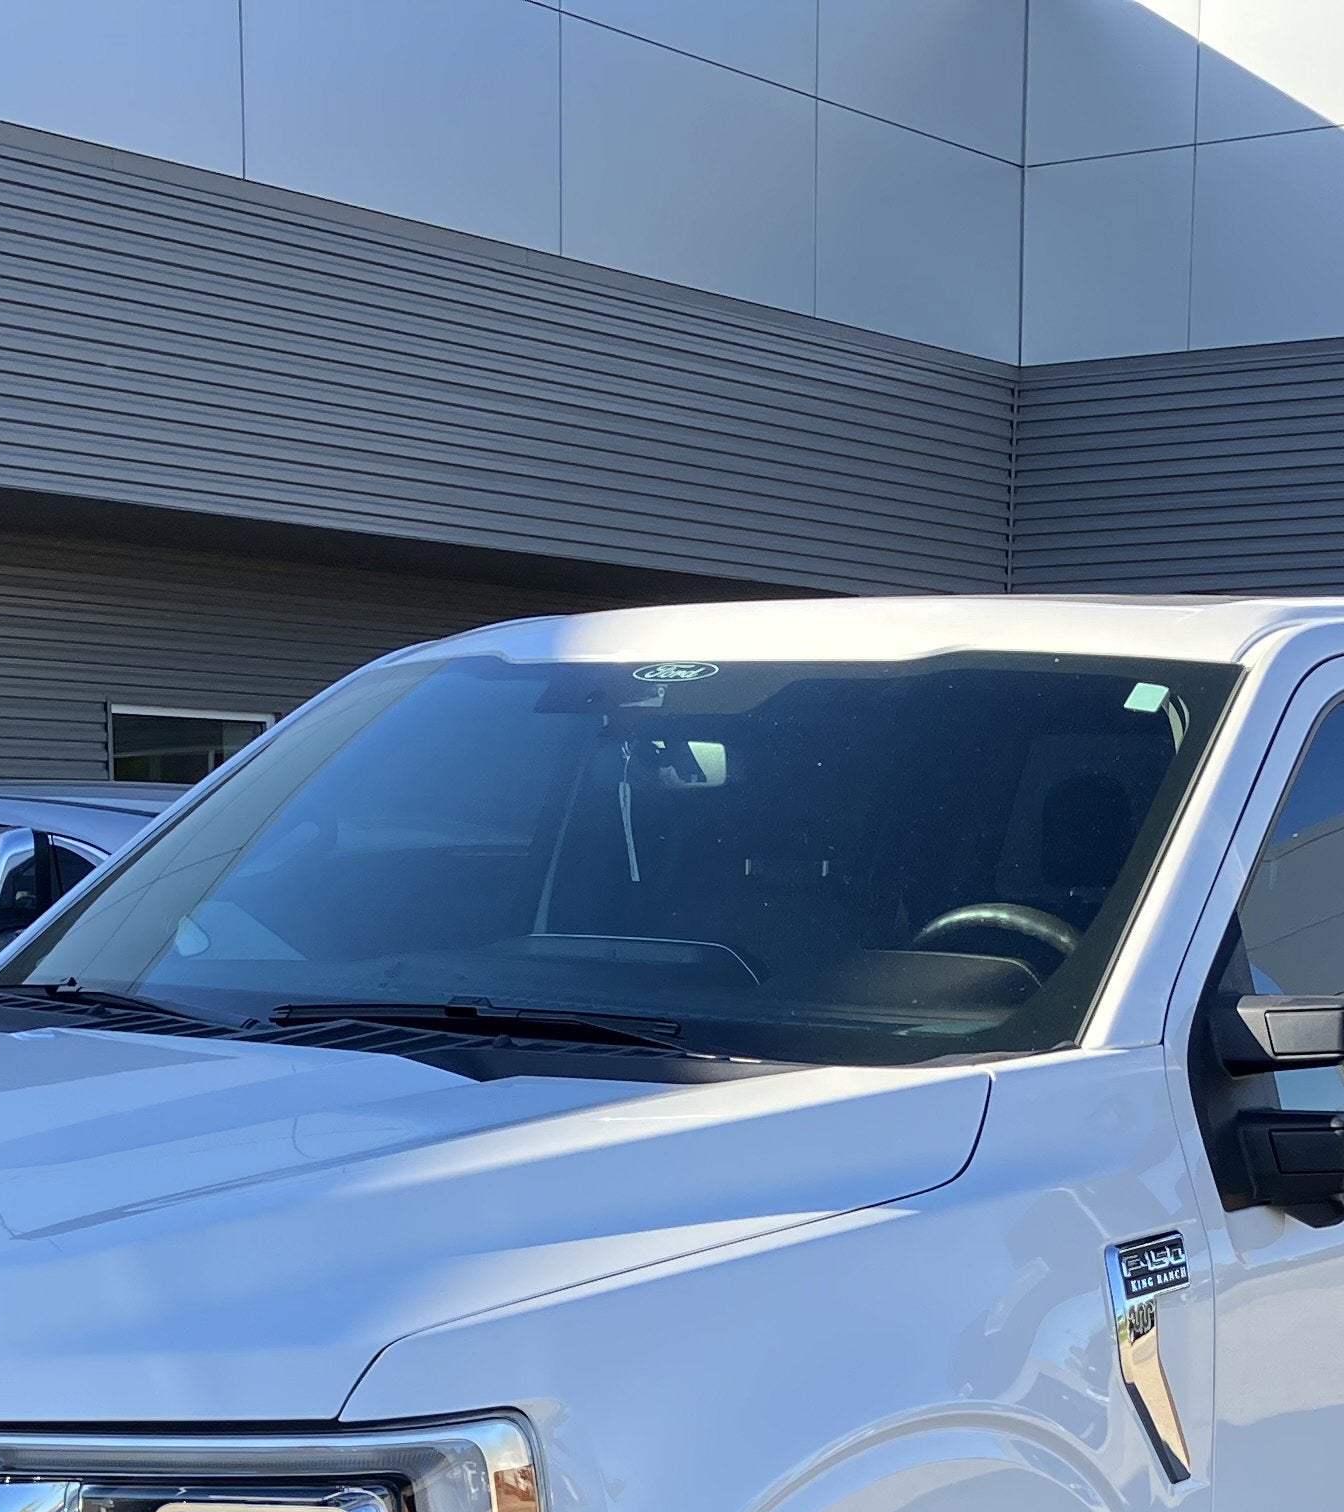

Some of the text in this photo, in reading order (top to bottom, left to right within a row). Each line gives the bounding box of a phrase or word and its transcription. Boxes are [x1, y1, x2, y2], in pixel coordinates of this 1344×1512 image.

[644, 664, 706, 678] Ford
[1131, 1266, 1186, 1291] KING RANCH
